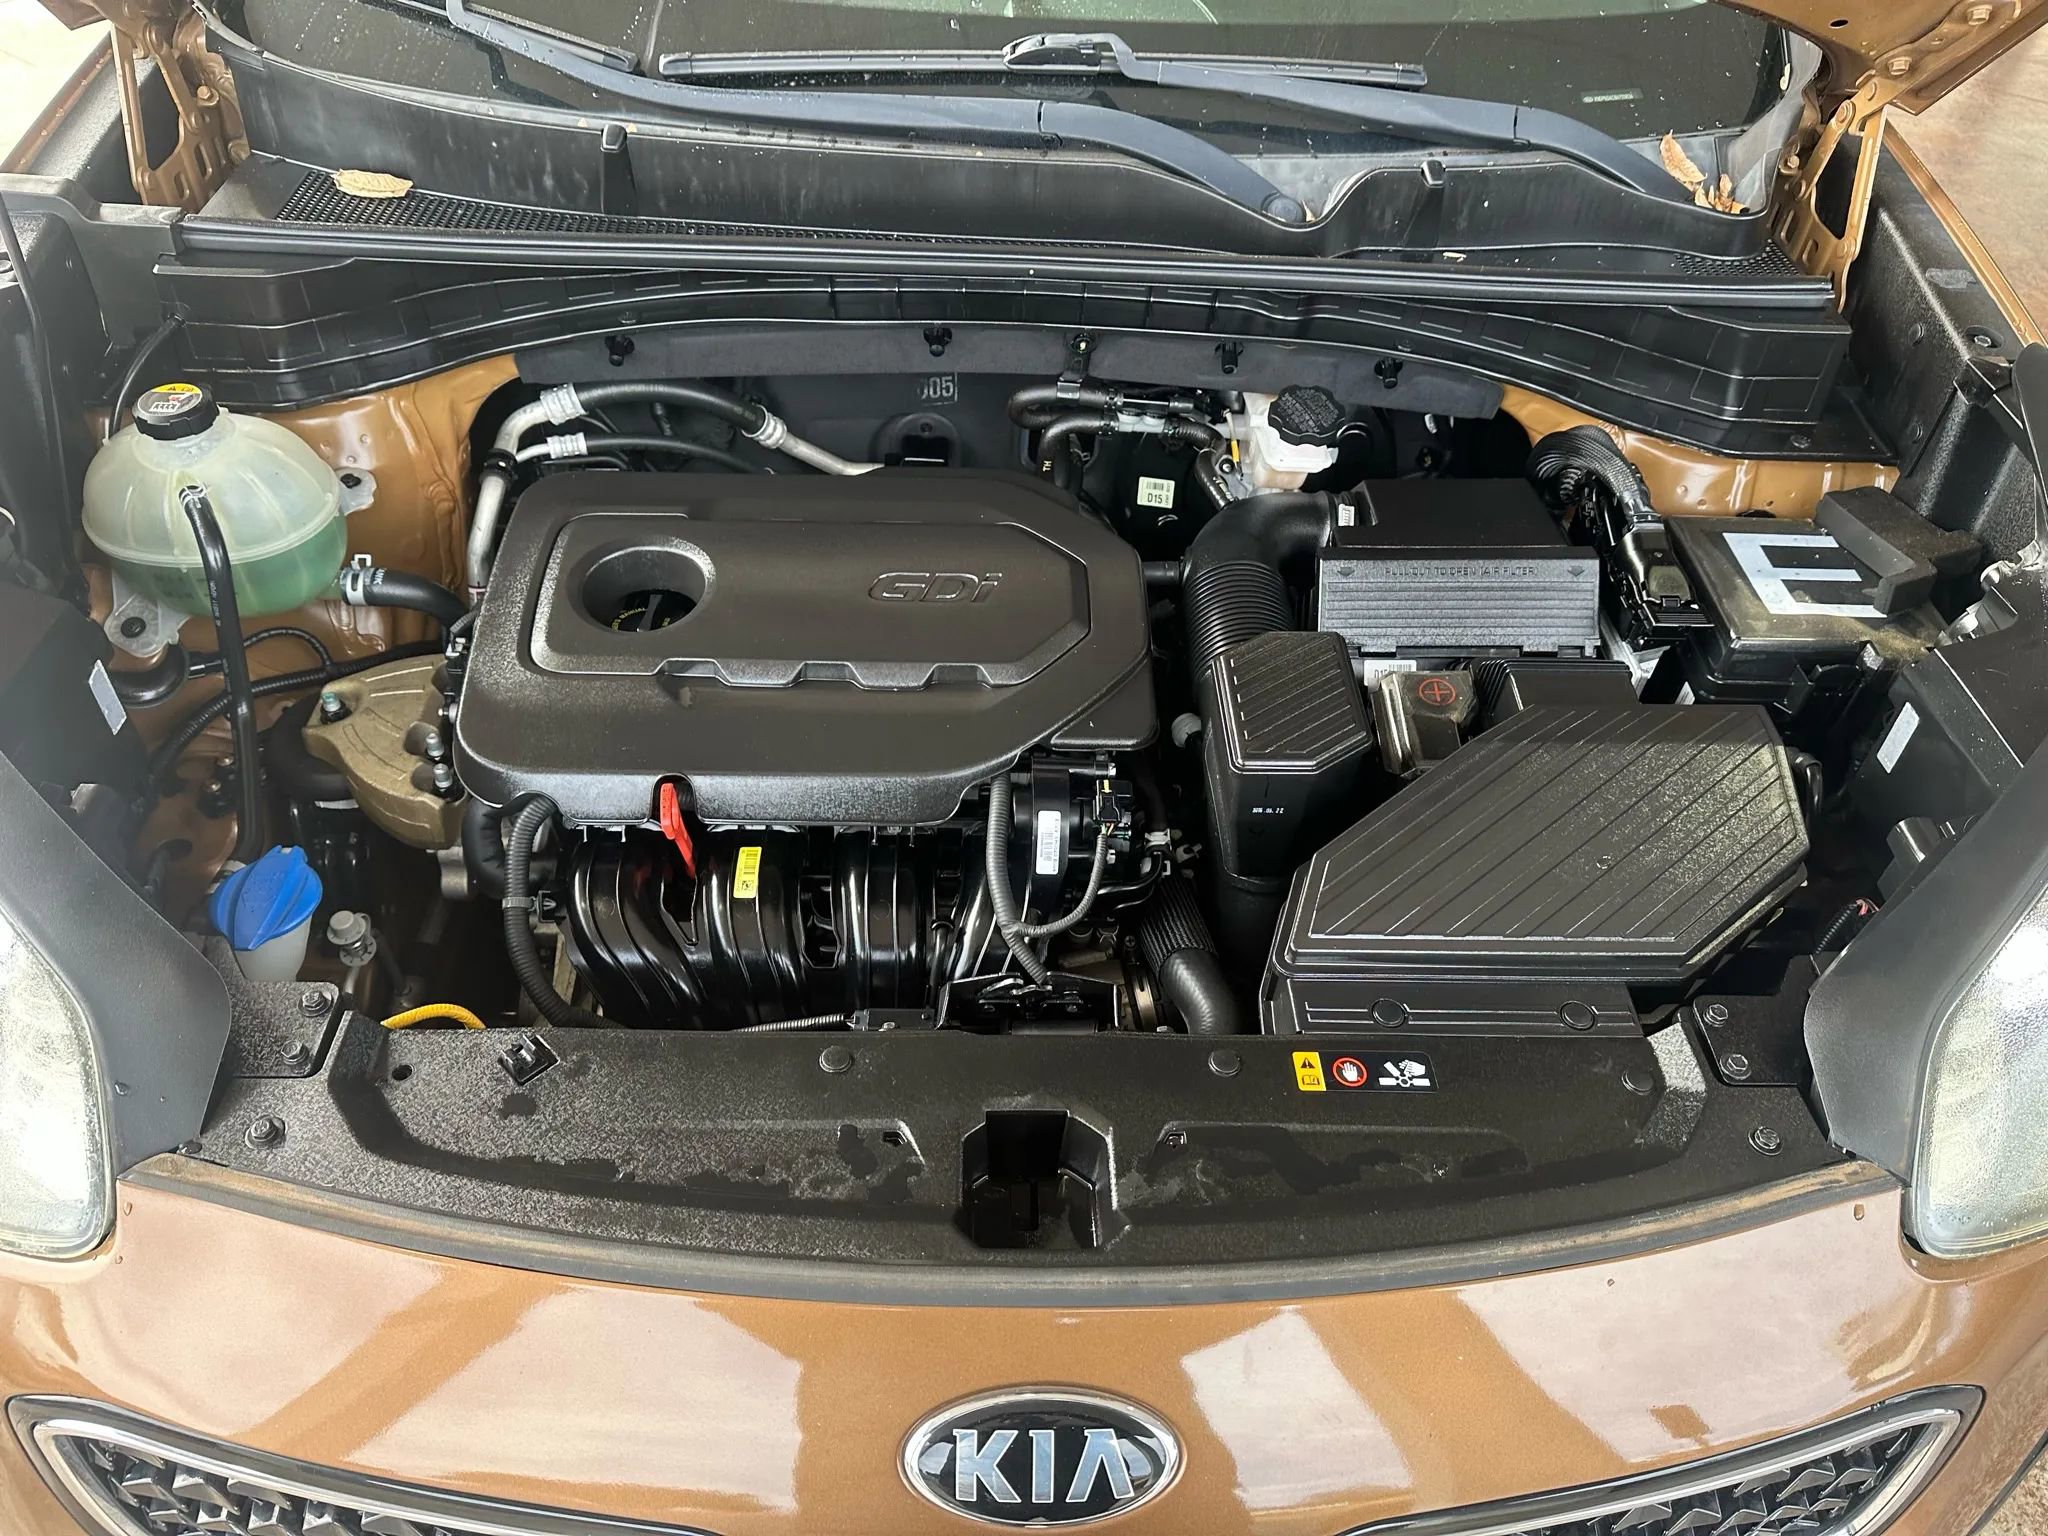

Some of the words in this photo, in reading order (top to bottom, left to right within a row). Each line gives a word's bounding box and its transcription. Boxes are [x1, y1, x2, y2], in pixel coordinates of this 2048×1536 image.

[1147, 492, 1163, 504] D15
[867, 571, 1003, 602] GDi
[952, 1428, 1135, 1503] KIA
